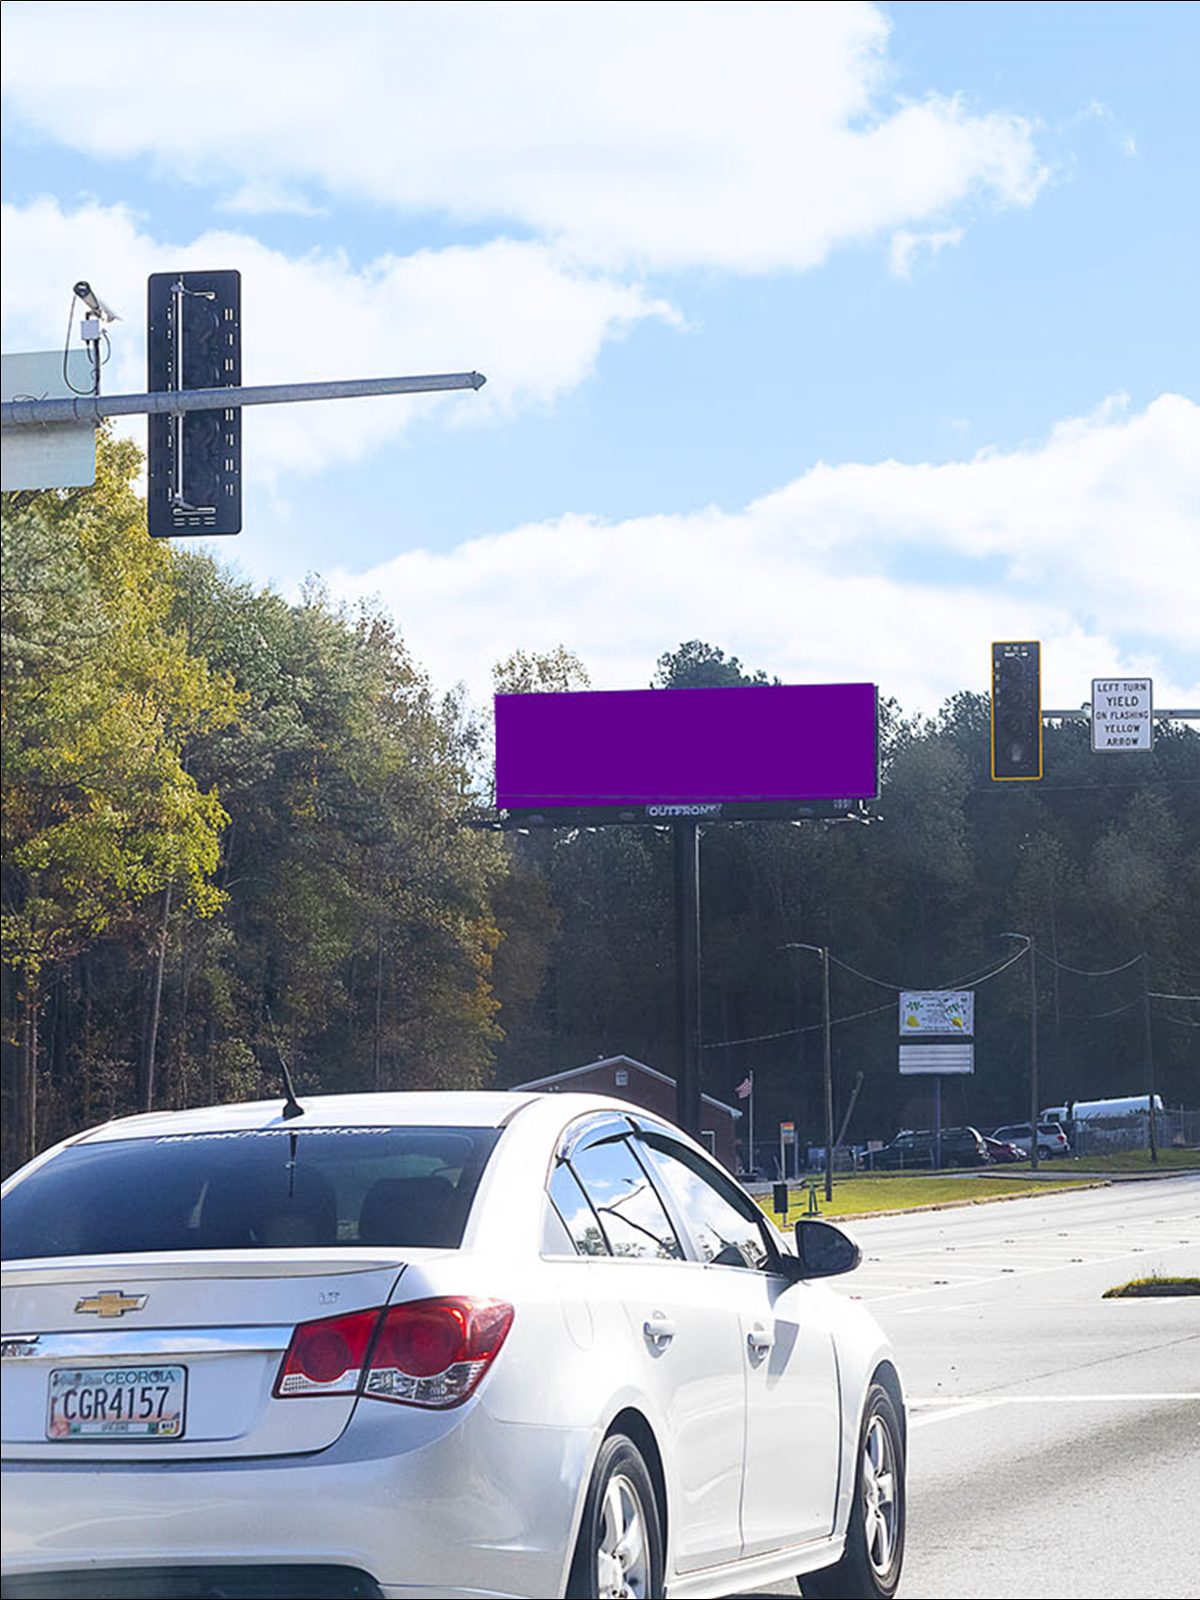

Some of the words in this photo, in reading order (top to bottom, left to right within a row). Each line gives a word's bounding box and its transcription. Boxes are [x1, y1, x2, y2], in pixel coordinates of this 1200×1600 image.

[1097, 683, 1119, 692] LEFT
[1123, 683, 1147, 691] TURN
[1106, 696, 1139, 707] YIELD
[1096, 711, 1107, 720] ON
[1110, 711, 1149, 720] FLASHING
[1104, 724, 1140, 733] YELLOW
[1106, 738, 1139, 746] ARROW
[103, 1370, 176, 1384] GEORGIA
[64, 1386, 169, 1420] CGR4157
